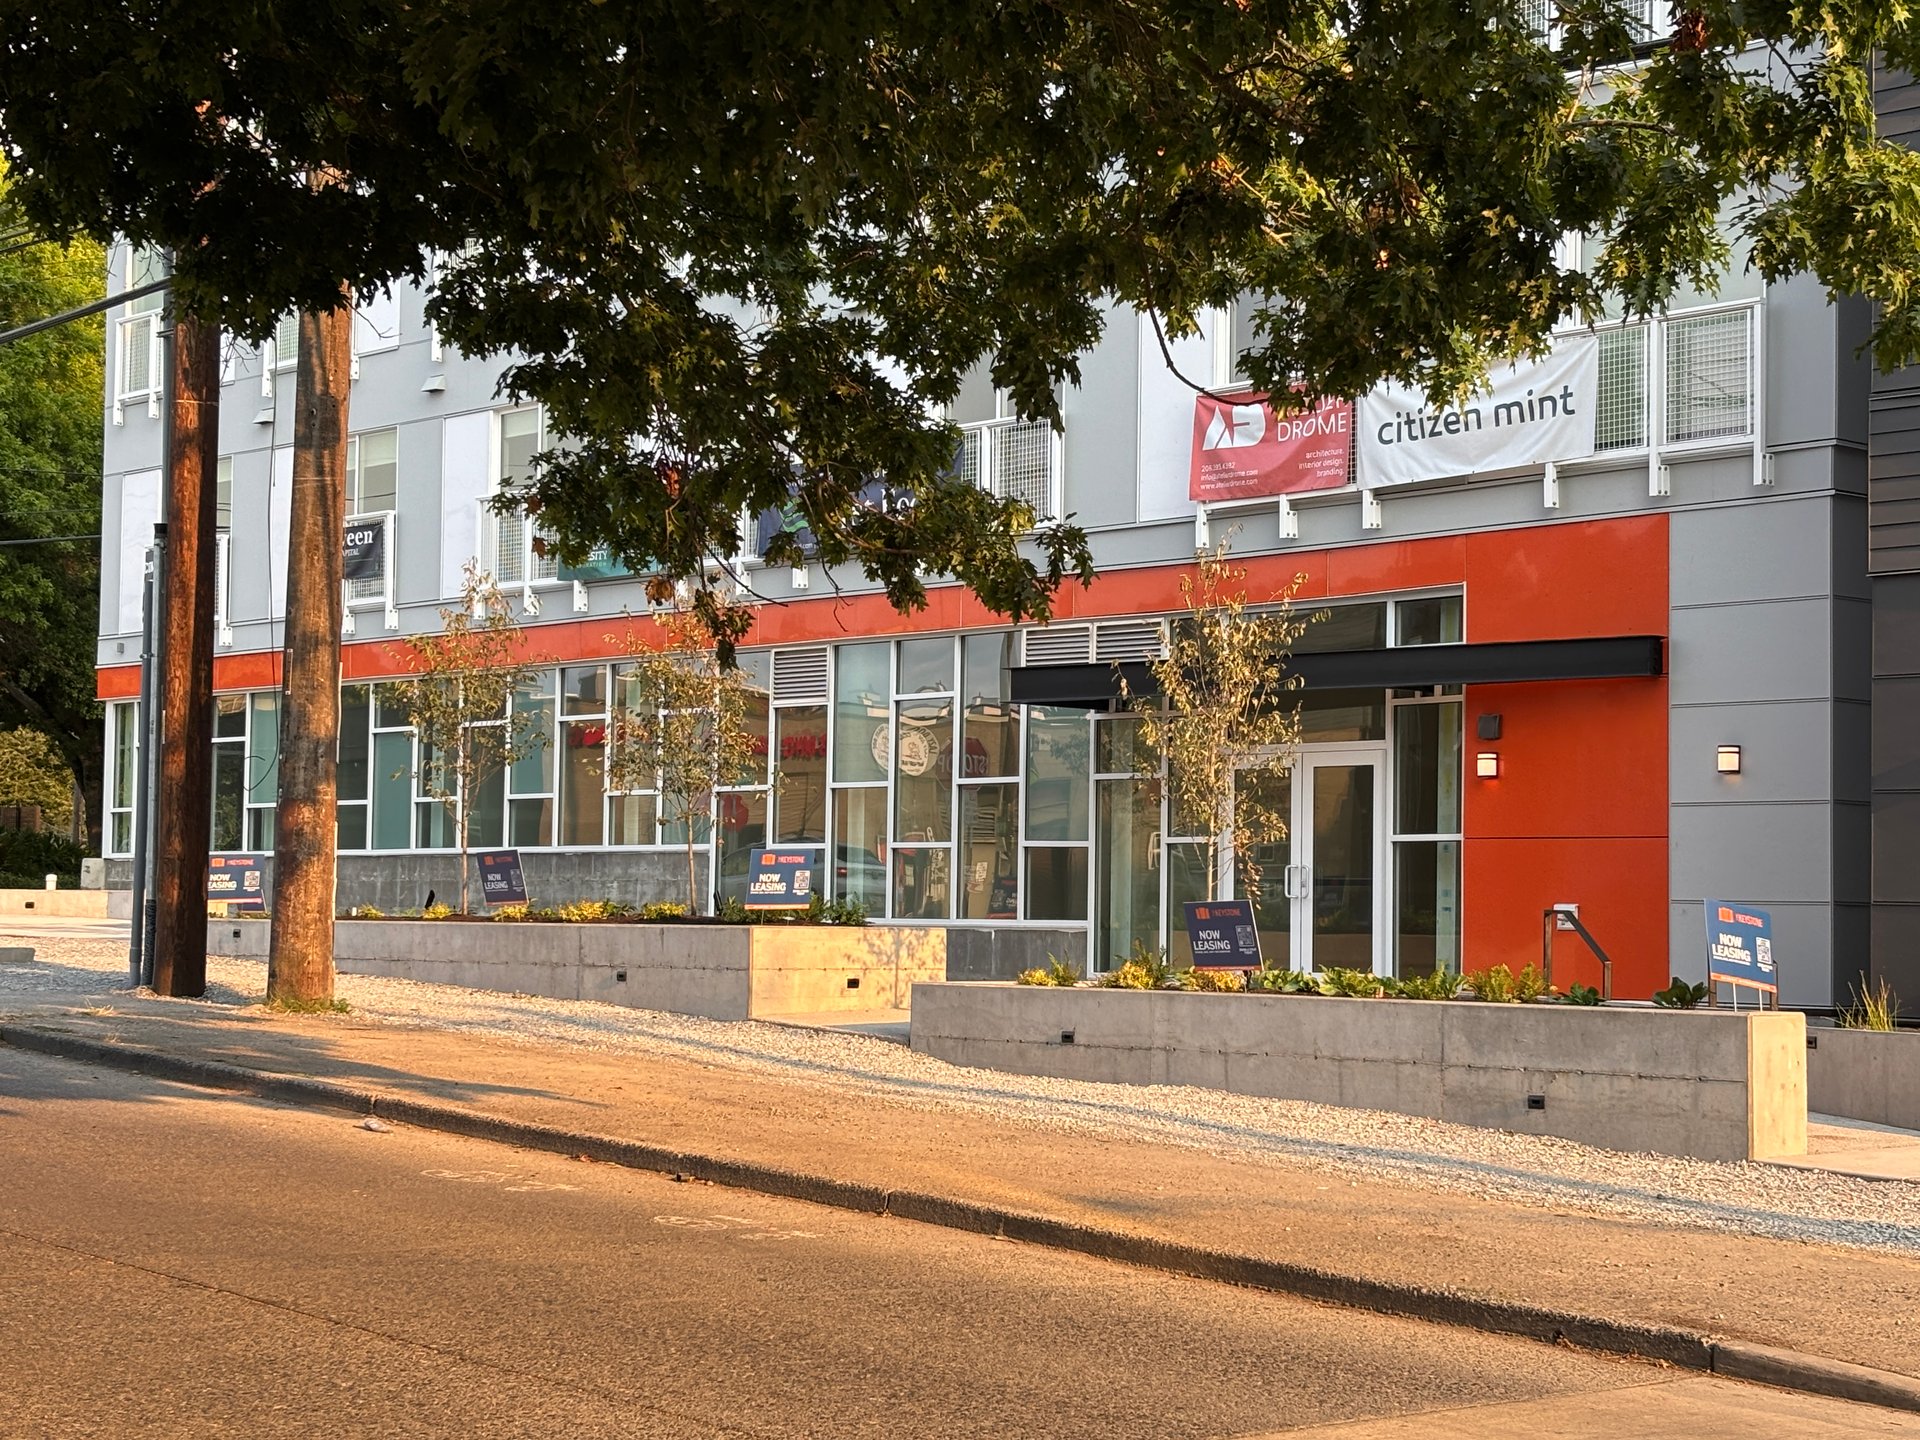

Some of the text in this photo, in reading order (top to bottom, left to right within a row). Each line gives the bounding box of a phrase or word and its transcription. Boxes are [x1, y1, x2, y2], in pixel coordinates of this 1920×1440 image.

[1377, 385, 1576, 446] citizen mint
[1277, 411, 1347, 442] DROME
[342, 530, 374, 547] een
[209, 873, 231, 882] NOW
[759, 873, 781, 882] NOW
[208, 881, 237, 889] EASING
[484, 881, 509, 890] LEASING
[750, 882, 787, 892] LEASING
[1199, 929, 1220, 940] NOW
[1719, 932, 1742, 948] NOW
[1193, 940, 1231, 951] LEASING
[1712, 943, 1751, 962] LEASING
